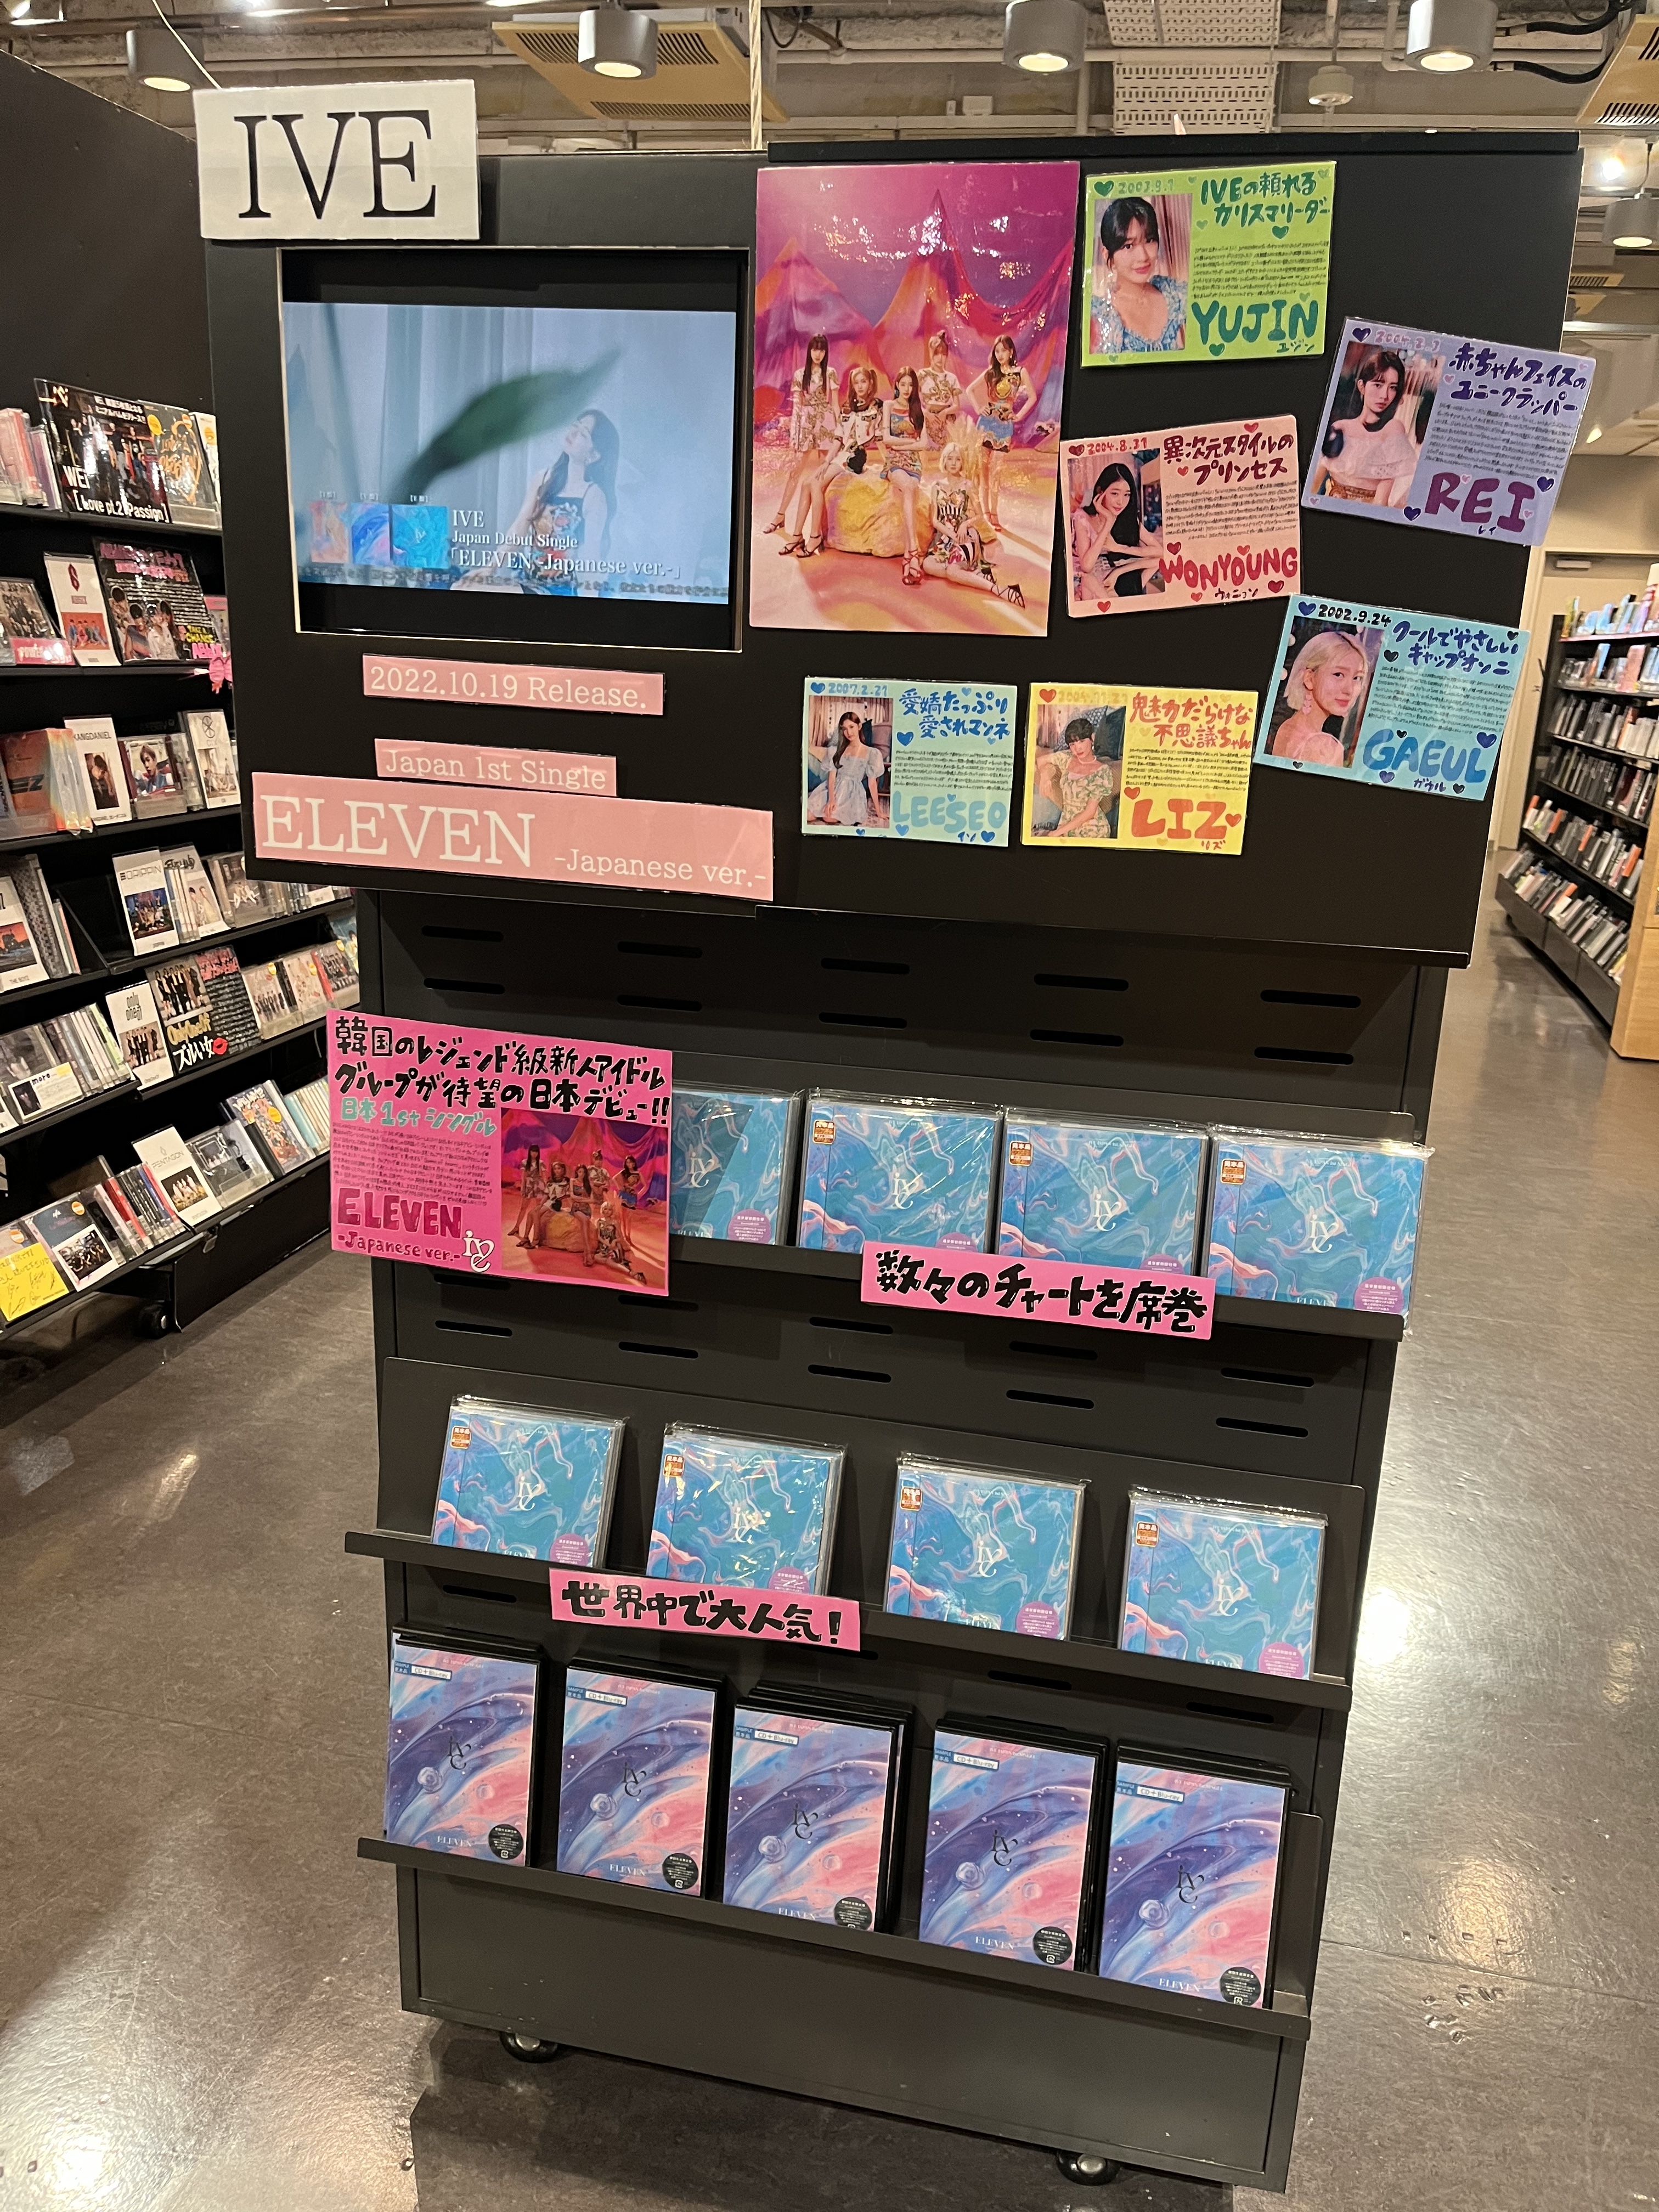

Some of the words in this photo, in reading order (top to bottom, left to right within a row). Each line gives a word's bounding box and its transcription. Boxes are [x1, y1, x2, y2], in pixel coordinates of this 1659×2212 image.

[234, 109, 436, 219] IVE
[1200, 171, 1317, 205] IVEの頼れる
[1213, 195, 1331, 228] カリスマリーダー
[1191, 300, 1318, 345] YUJIN
[1276, 338, 1316, 353] ユジン
[1374, 330, 1441, 353] 2004.2.3
[1448, 342, 1588, 390] 赤ちゃんフェイスの
[1451, 380, 1579, 416] ユニークラッパー
[1086, 437, 1148, 456] 2004.8.31
[1163, 431, 1295, 465] 異次元スタイルの
[1193, 458, 1288, 486] プリンセス
[453, 509, 484, 527] IVE
[1424, 472, 1536, 533] REI
[452, 529, 490, 546] Japan
[494, 531, 534, 547] Debut
[537, 533, 578, 550] Single
[1477, 525, 1497, 536] レイ
[1158, 546, 1299, 591] WONYOUNG
[1318, 603, 1392, 627] 2002.9.24
[1392, 620, 1519, 655] クールでやさしい
[1408, 642, 1511, 675] ギャップオンニ
[370, 665, 518, 699] 2022.10.19
[527, 676, 647, 709] Release.
[828, 682, 888, 697] 2007.2.21
[899, 687, 1008, 715] 愛嬌たっぷり
[918, 715, 1011, 740] 愛されマンネ
[1153, 723, 1252, 750] 不思議ちゃん
[386, 749, 466, 778] Japan
[476, 755, 513, 782] 1st
[521, 760, 606, 791] Single
[1362, 728, 1487, 784] GAEUL
[1413, 778, 1447, 792] ガウル
[892, 791, 1007, 833] LEESEO
[1131, 798, 1228, 839] LIZ
[259, 794, 536, 867] ELEVEN
[554, 848, 693, 881] -Japanese
[702, 863, 766, 889] ver.-
[957, 831, 977, 843] イソ
[1201, 840, 1227, 851] リズ
[335, 1015, 665, 1091] 韓国のレジェンド級新人アイドル
[337, 1187, 463, 1239] ELEVEN
[337, 1231, 421, 1259] -Japanese
[426, 1246, 461, 1263] ver.-
[875, 1249, 1209, 1333] 数々のチャートを席巻
